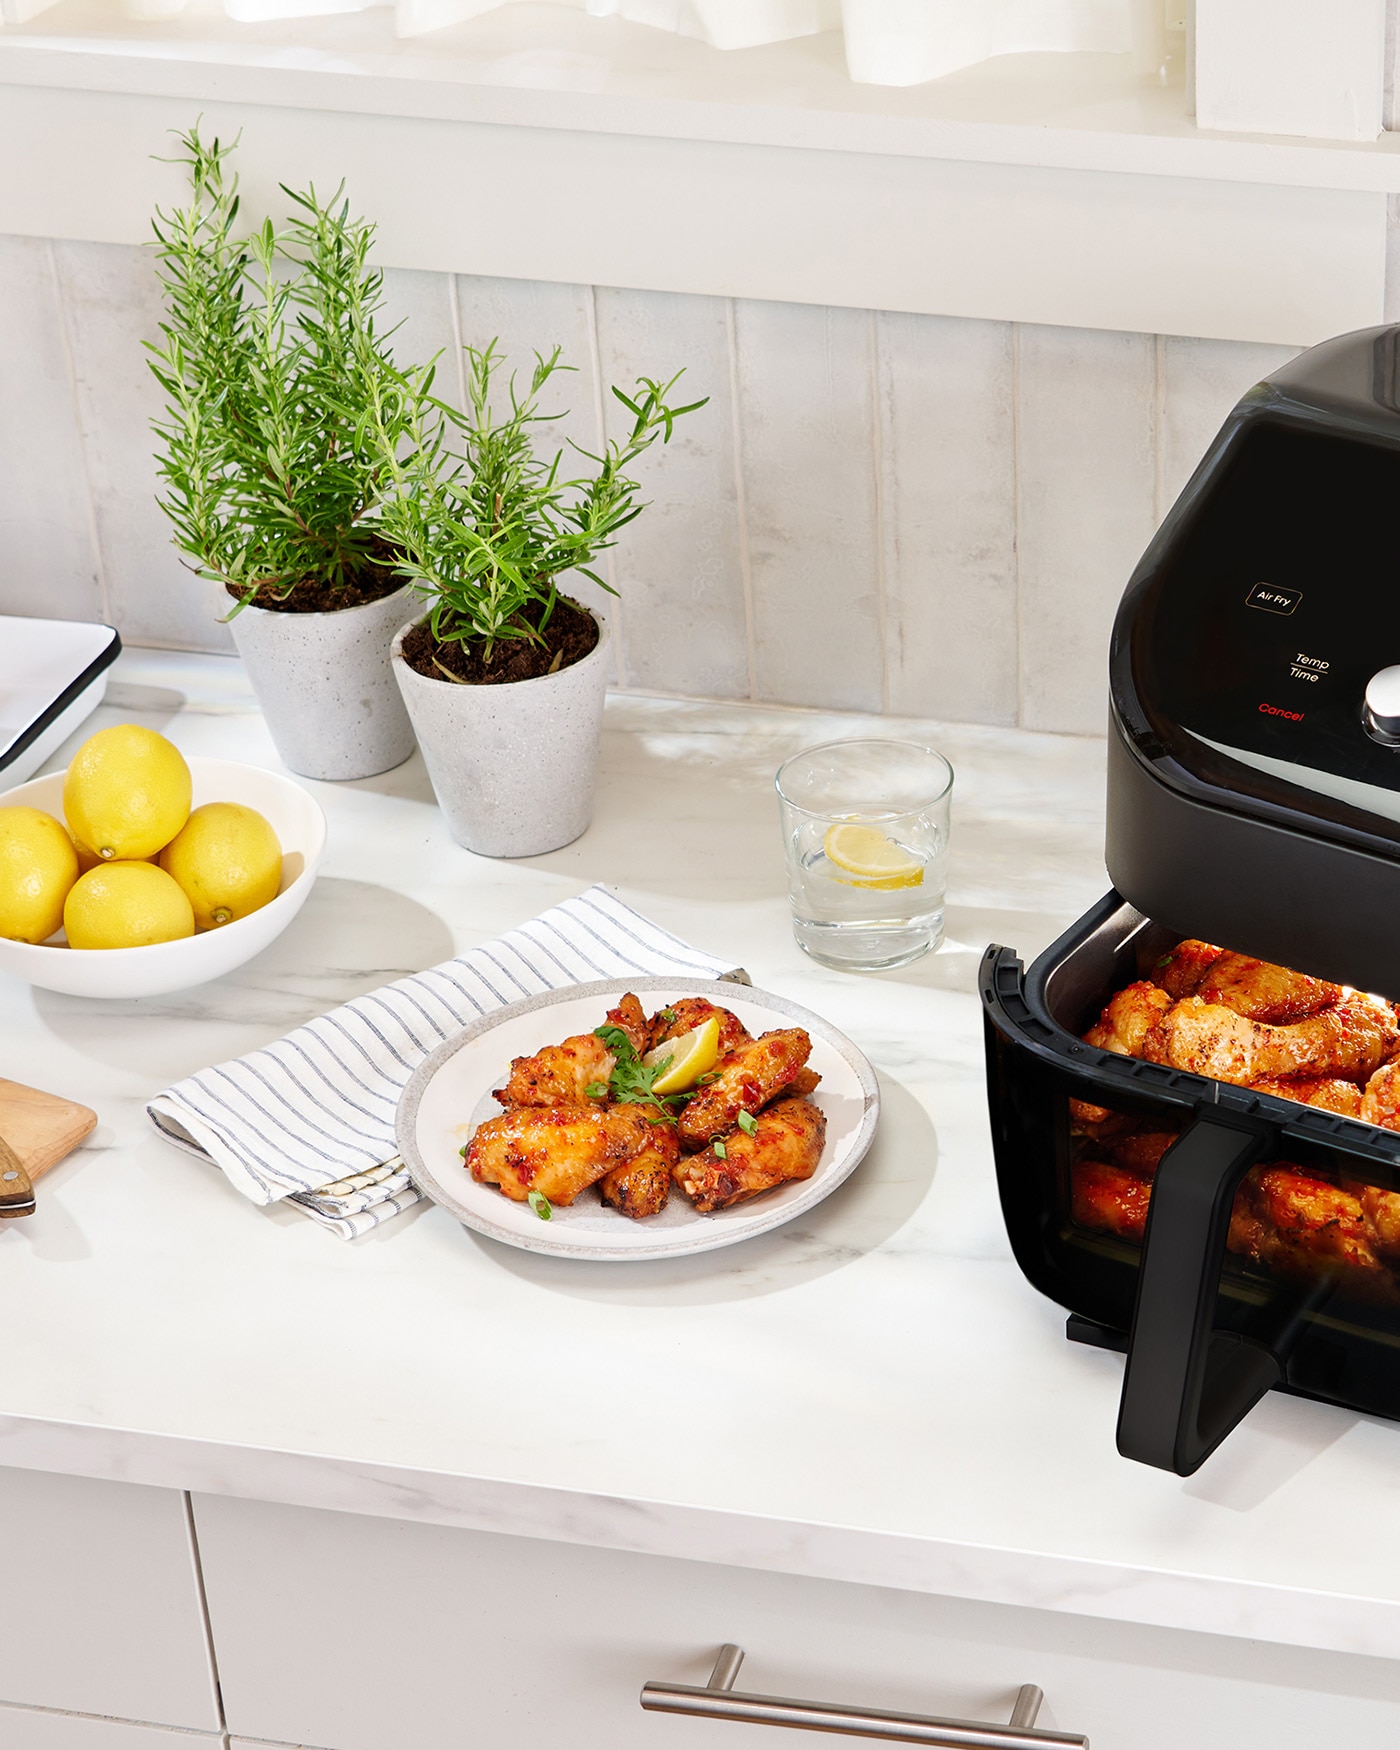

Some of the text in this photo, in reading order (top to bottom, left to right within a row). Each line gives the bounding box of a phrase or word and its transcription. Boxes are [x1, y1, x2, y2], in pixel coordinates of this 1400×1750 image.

[1257, 591, 1292, 607] Air Fry
[1296, 653, 1330, 670] Temp
[1290, 668, 1319, 683] Time
[1258, 703, 1305, 722] Cancel
